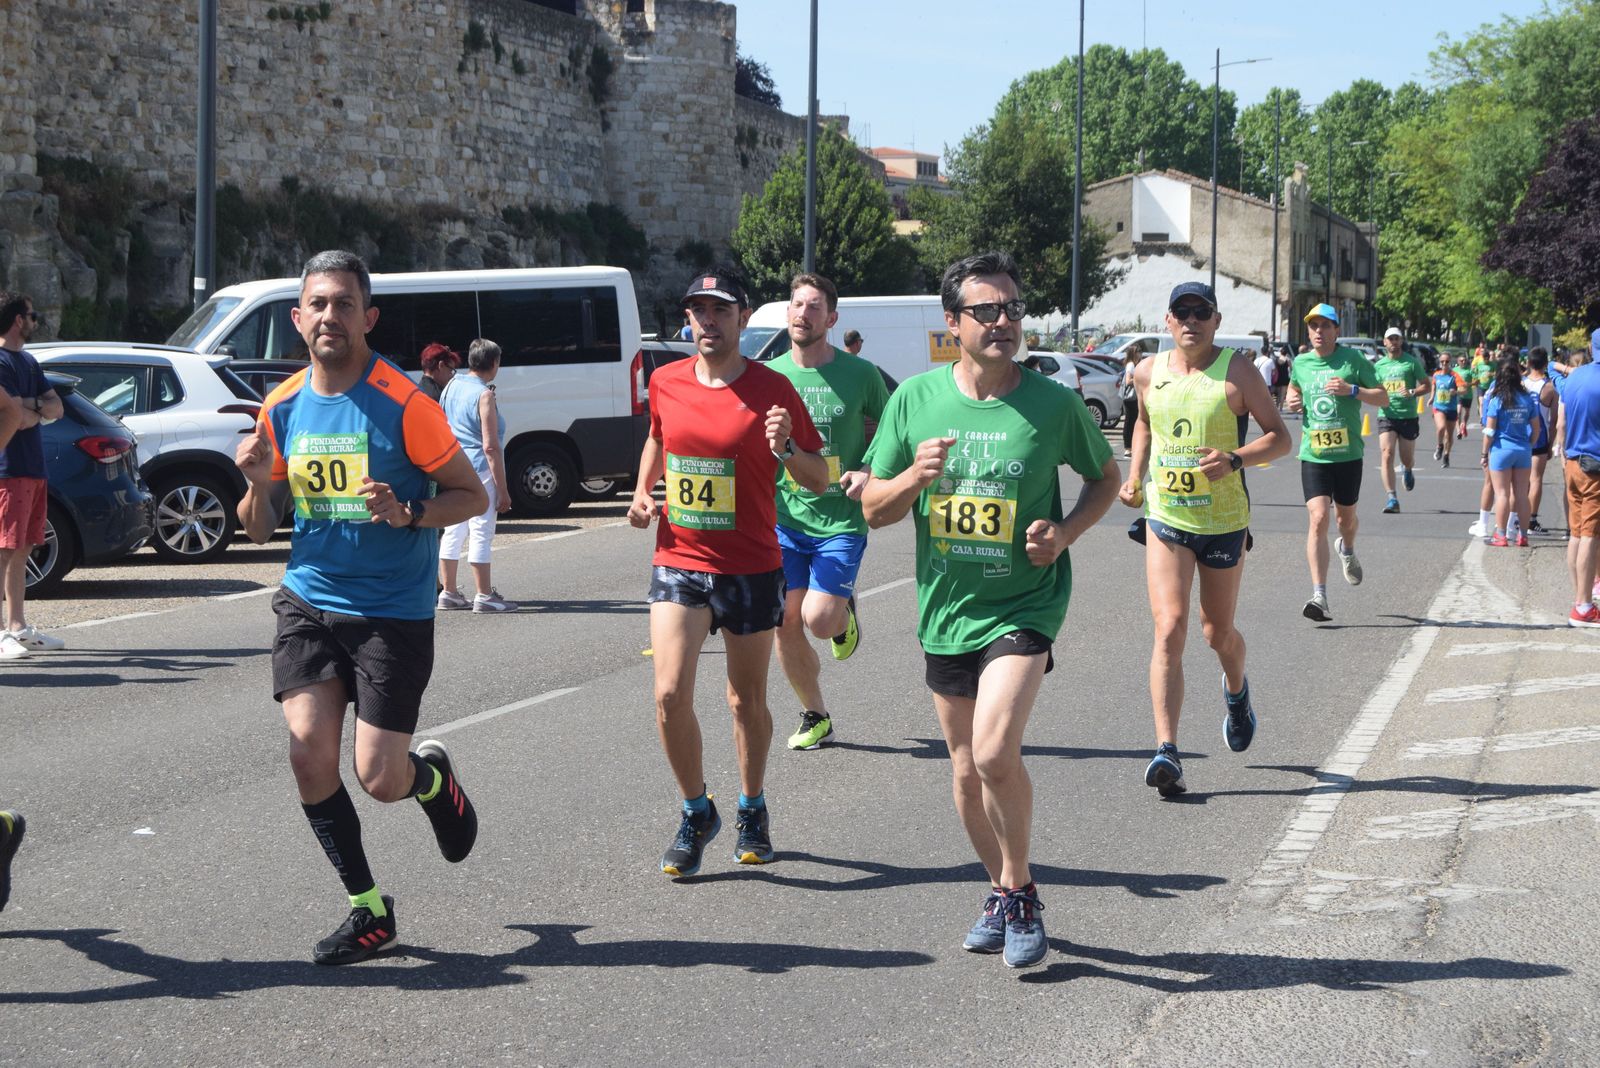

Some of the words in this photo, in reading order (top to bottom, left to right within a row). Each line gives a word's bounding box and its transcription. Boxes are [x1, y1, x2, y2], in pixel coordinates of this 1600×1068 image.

[965, 431, 1007, 440] CARRERA
[1314, 431, 1342, 446] 133
[309, 437, 357, 446] FUNDACION
[310, 445, 327, 453] CAJA
[329, 445, 356, 453] RURAL
[681, 459, 725, 469] FUNDACION
[682, 466, 698, 474] CAJA
[700, 467, 724, 475] RURAL
[306, 460, 347, 493] 30
[955, 479, 1006, 489] FUNDACION
[1167, 471, 1195, 493] 29
[679, 478, 715, 507] 84
[976, 487, 1005, 497] RURAL
[313, 503, 334, 512] CAJA
[336, 503, 365, 512] RURAL
[682, 514, 700, 523] CAJA
[702, 515, 731, 525] RURAL
[940, 500, 1001, 536] 183
[952, 545, 973, 555] CAJA
[976, 547, 1007, 557] RURAL
